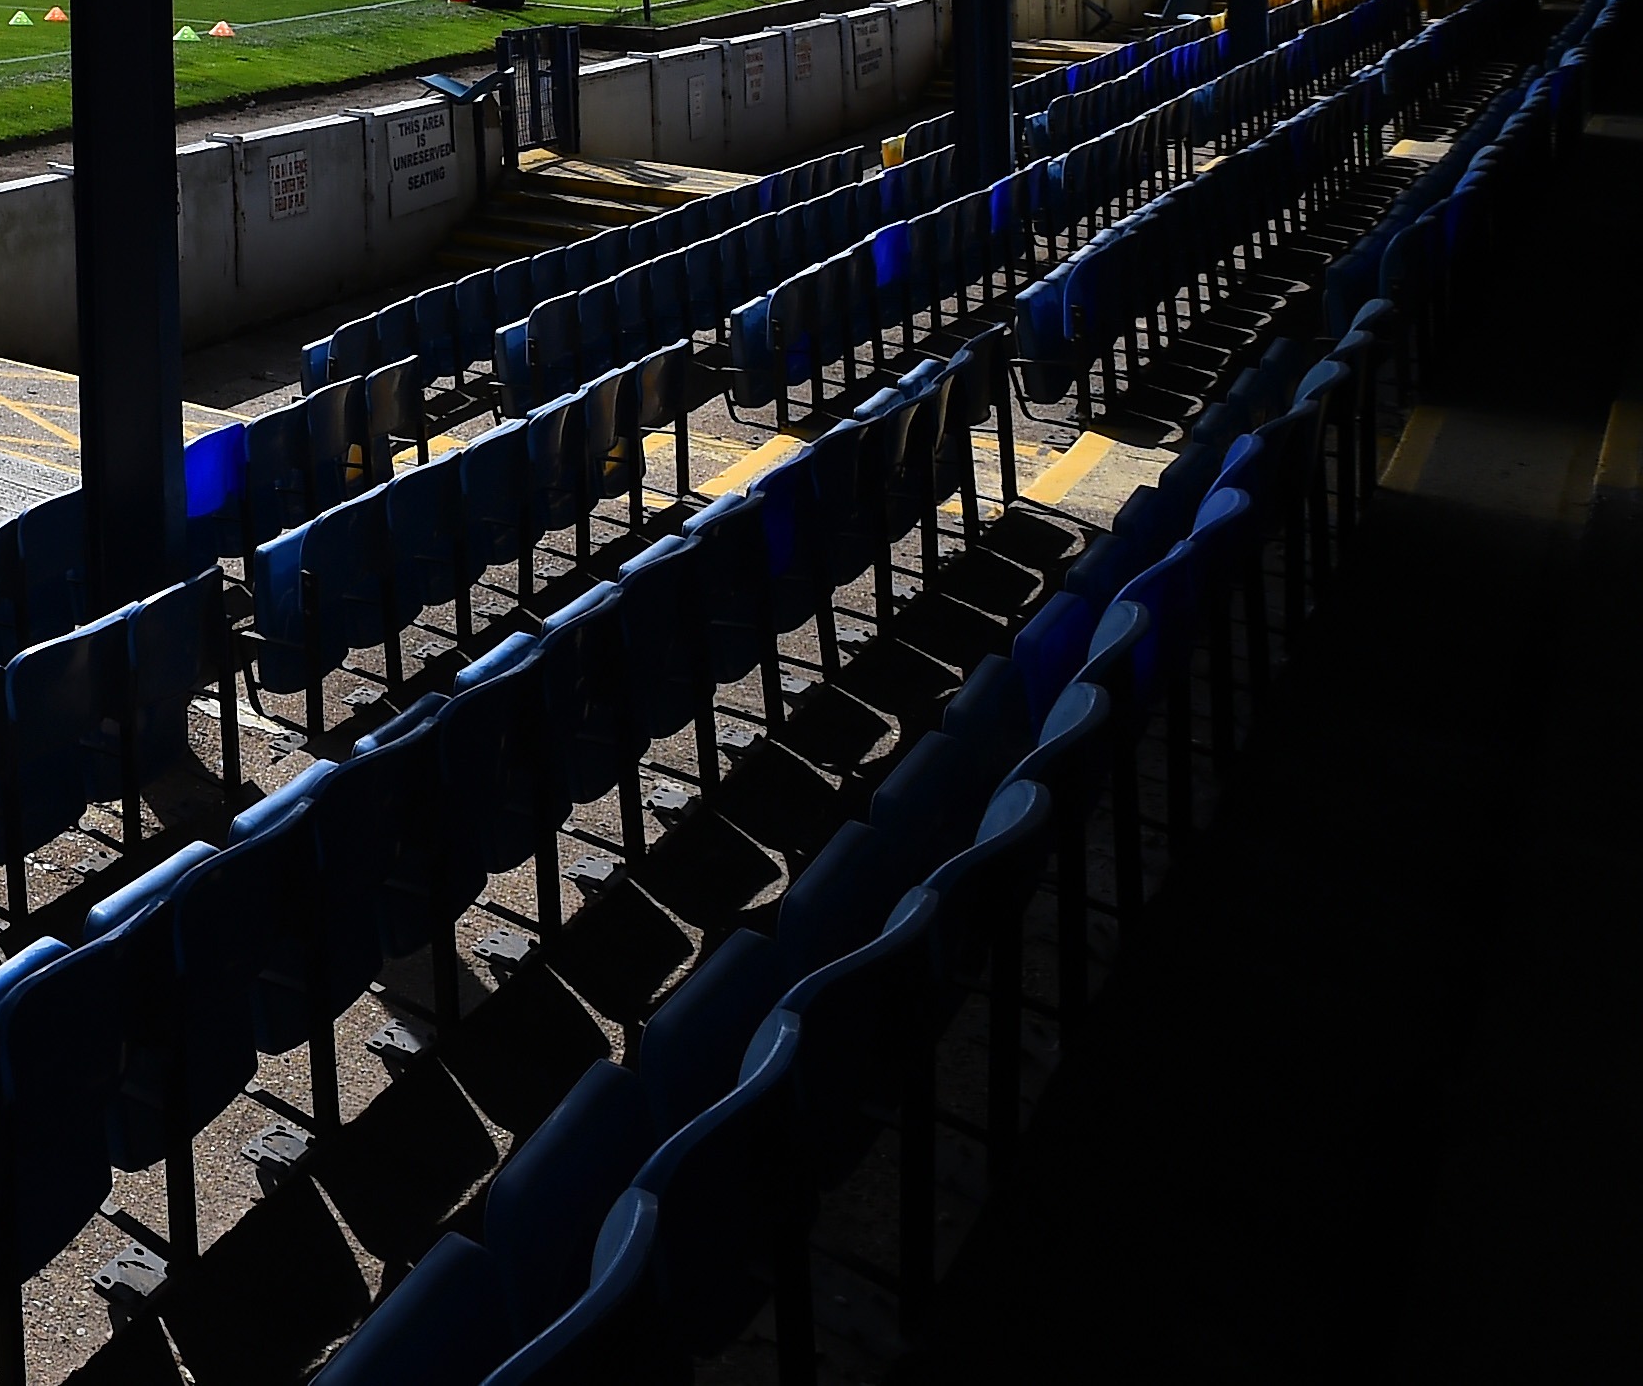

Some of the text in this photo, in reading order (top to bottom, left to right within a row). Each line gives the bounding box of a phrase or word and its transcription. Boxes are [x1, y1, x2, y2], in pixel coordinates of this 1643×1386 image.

[398, 114, 445, 136] THIS AREA
[417, 133, 426, 148] IS
[393, 143, 452, 171] UNRESERVED
[408, 166, 446, 190] SEATING
